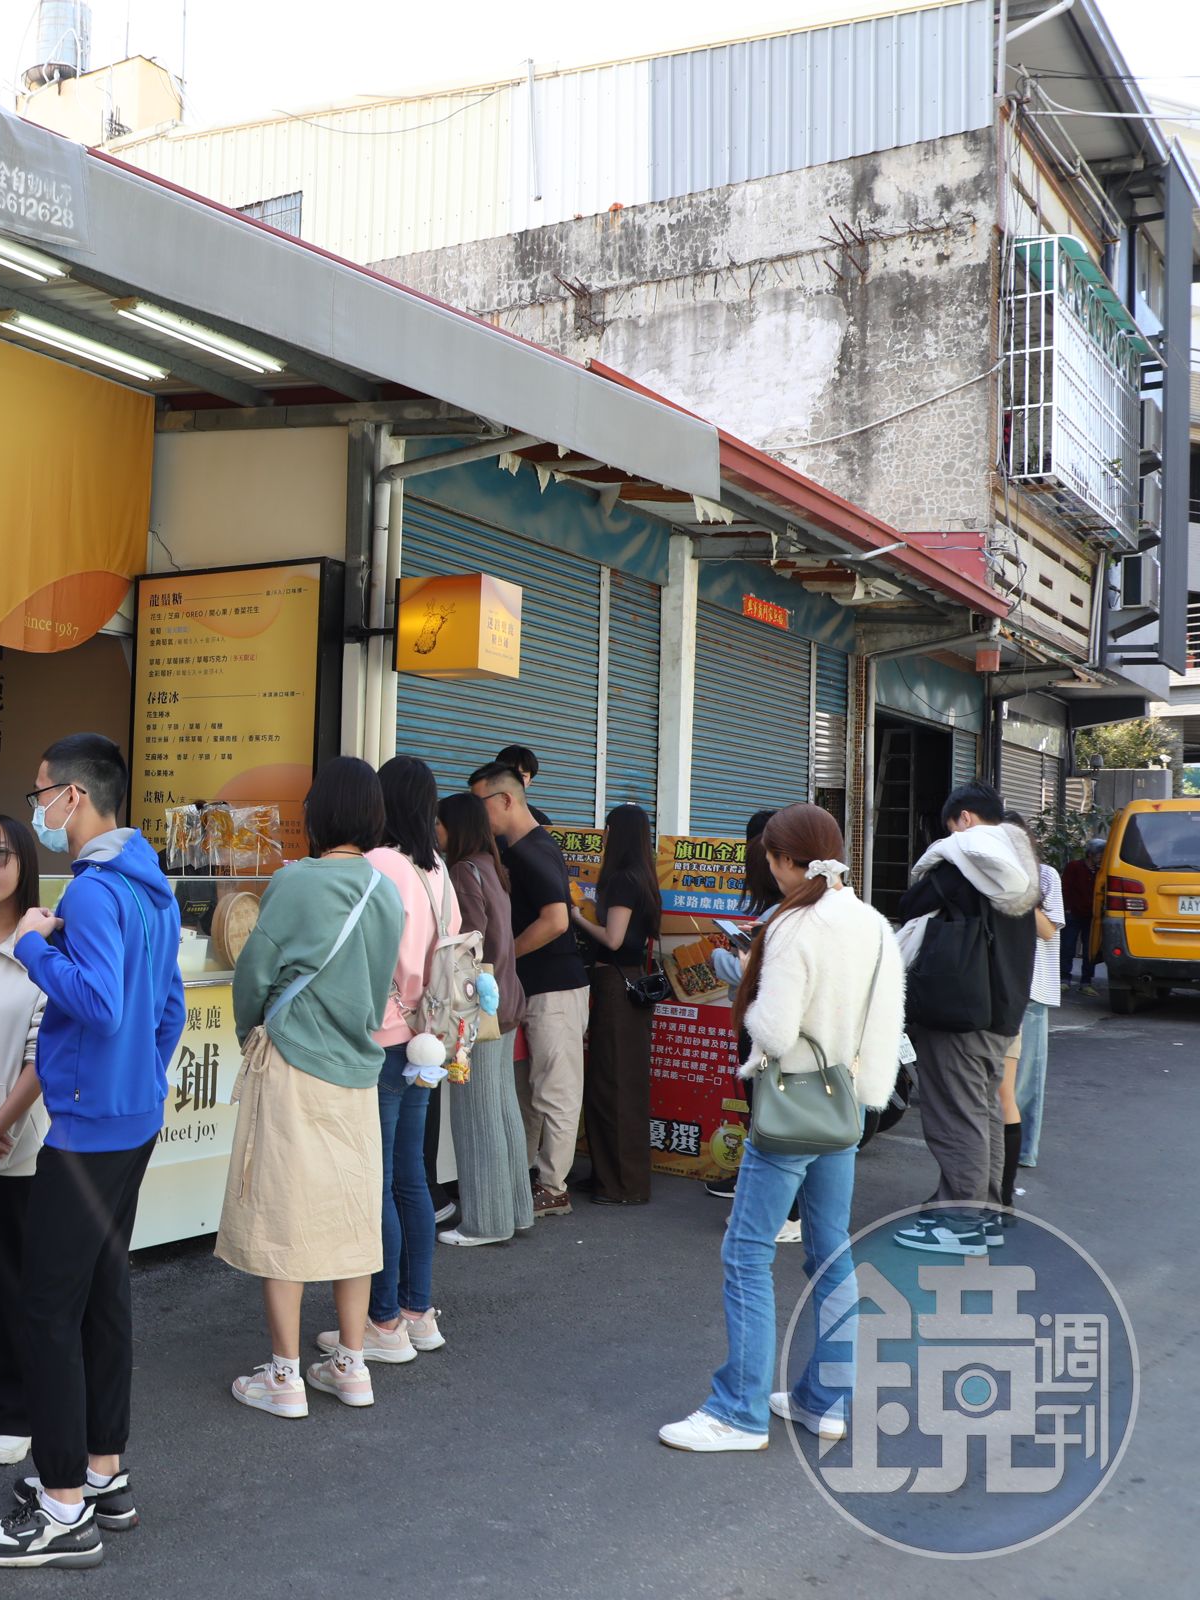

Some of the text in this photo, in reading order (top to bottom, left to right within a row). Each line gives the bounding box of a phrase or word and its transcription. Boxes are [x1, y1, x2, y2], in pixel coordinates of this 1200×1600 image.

[55, 622, 80, 642] 1987
[142, 817, 168, 832] 伴手
[186, 1004, 222, 1032] 麋鹿
[174, 1042, 220, 1113] 鋪
[158, 1119, 219, 1144] Meet joy
